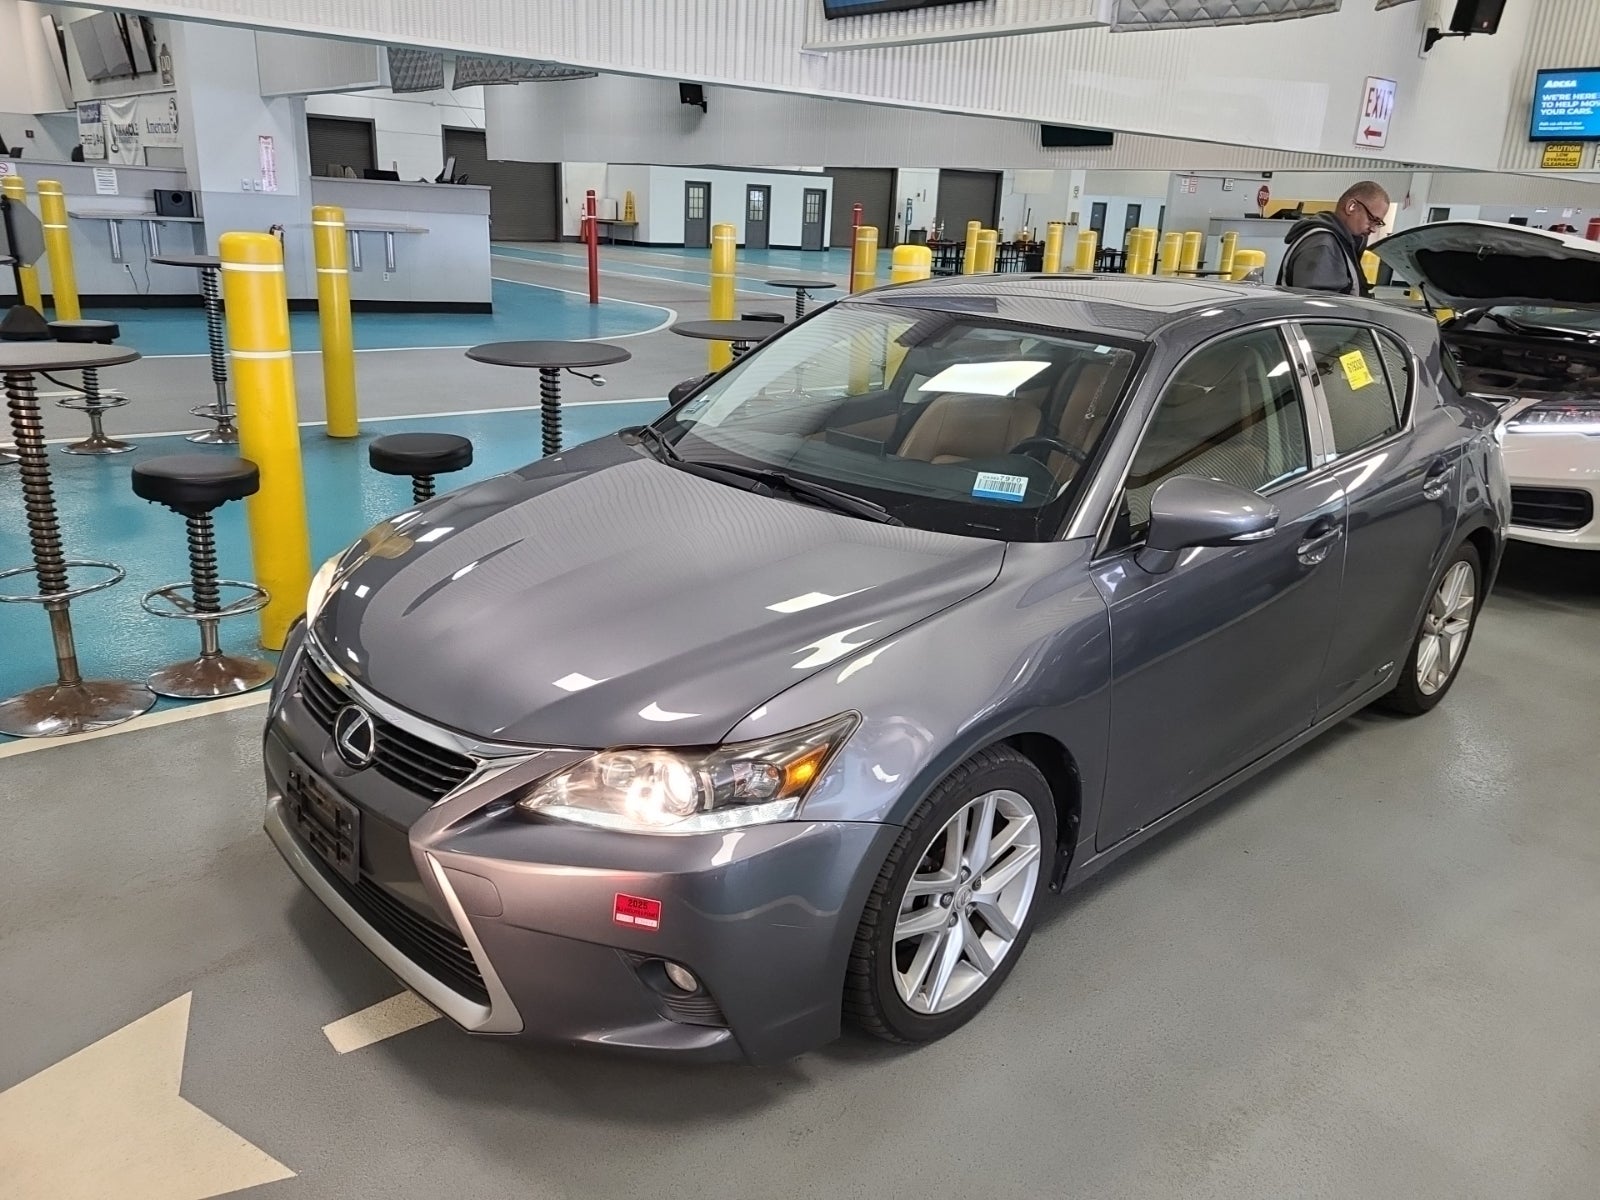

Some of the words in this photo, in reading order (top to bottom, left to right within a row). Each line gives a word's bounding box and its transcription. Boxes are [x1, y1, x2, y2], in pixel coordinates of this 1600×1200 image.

[1573, 92, 1597, 100] HERE
[1365, 87, 1393, 120] EXIT
[1567, 107, 1594, 115] CARS.
[1259, 191, 1270, 200] STOP
[627, 899, 648, 910] 2025
